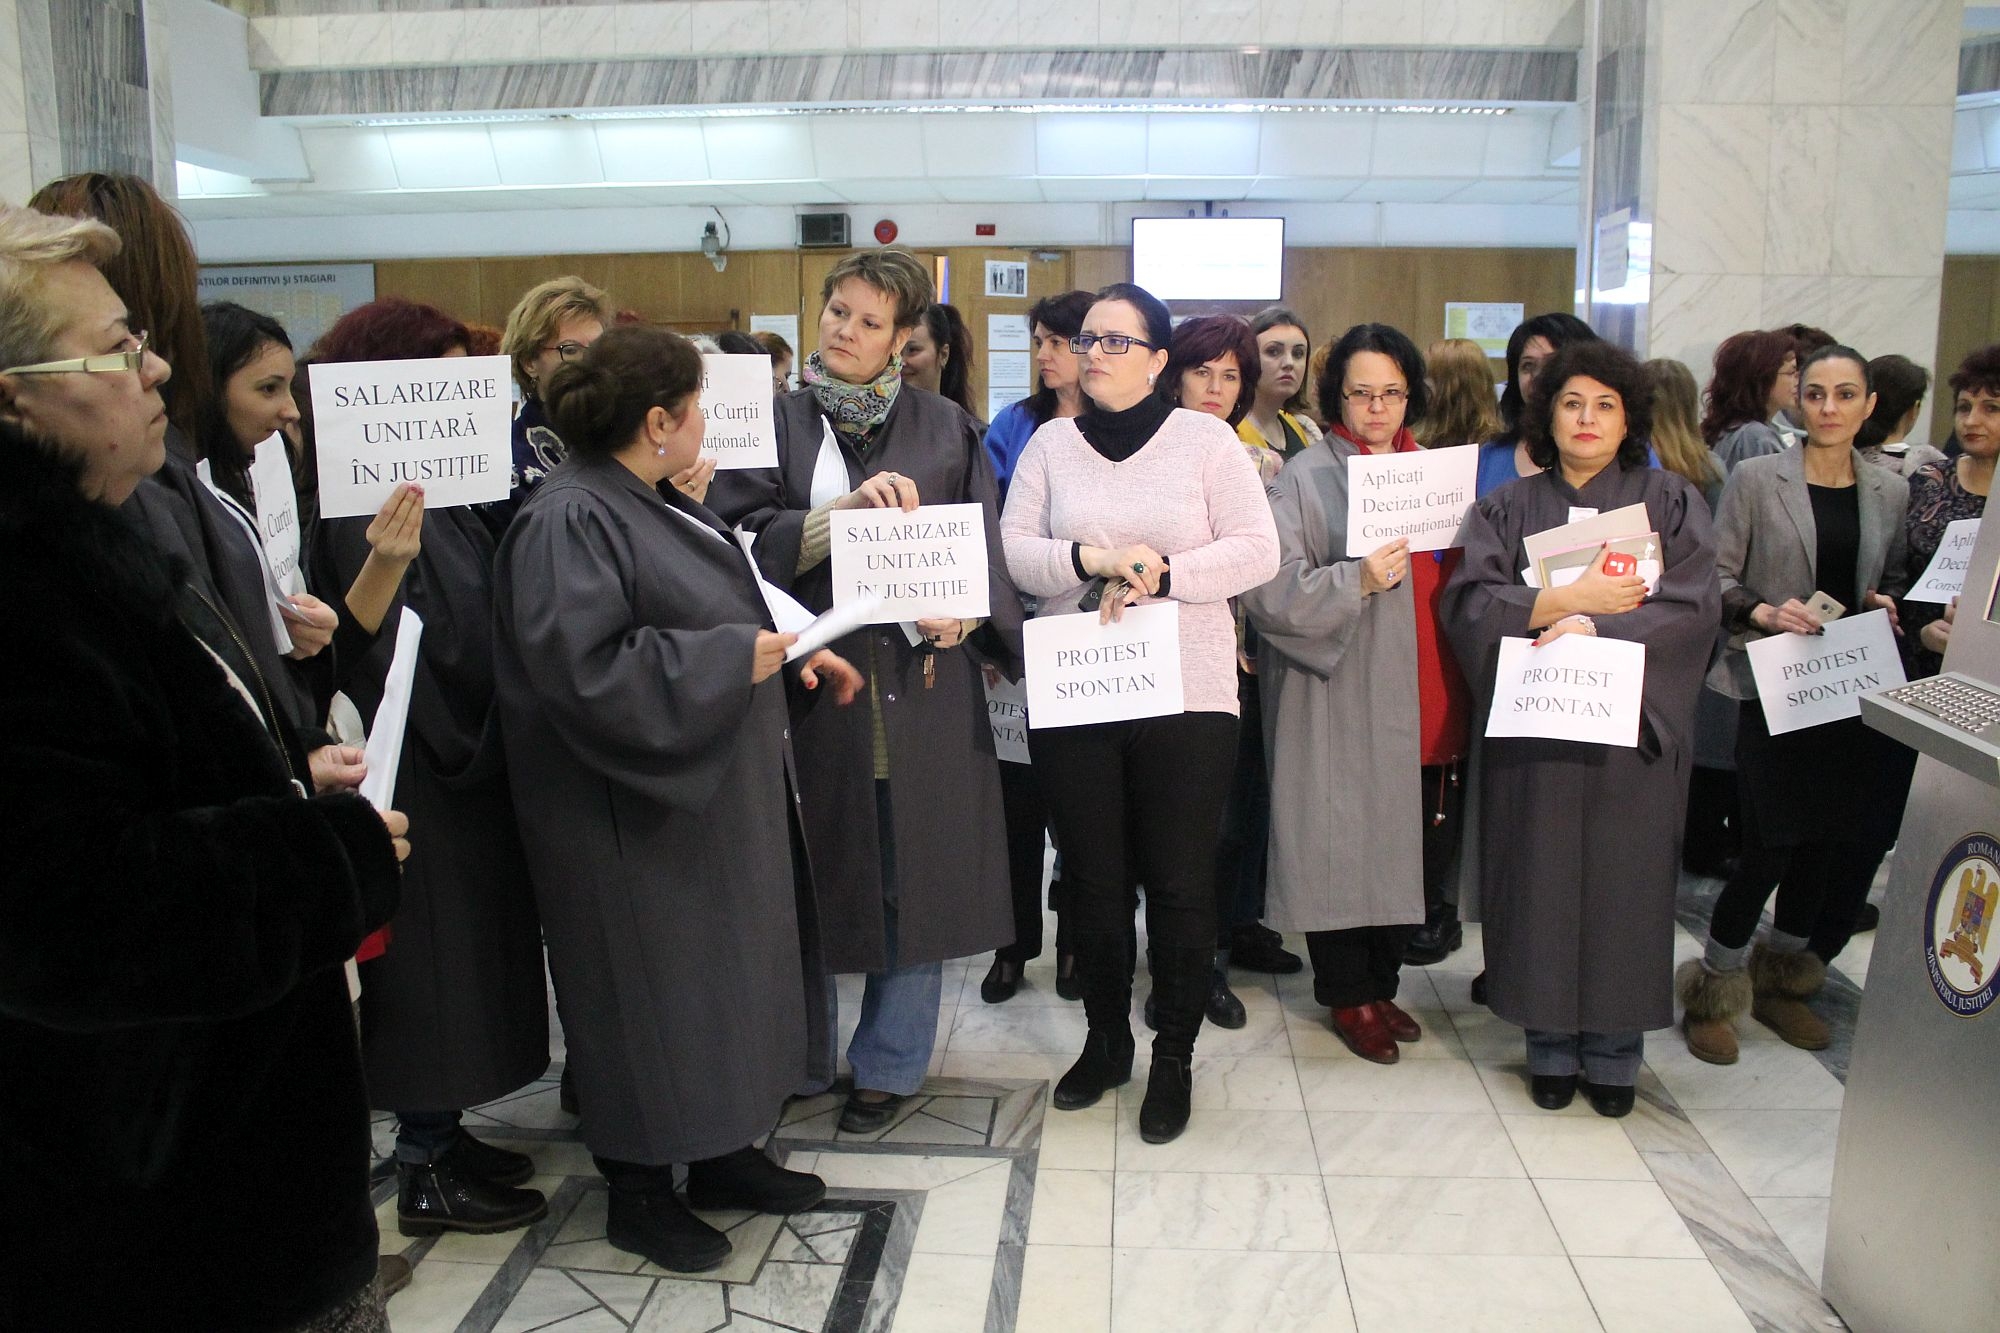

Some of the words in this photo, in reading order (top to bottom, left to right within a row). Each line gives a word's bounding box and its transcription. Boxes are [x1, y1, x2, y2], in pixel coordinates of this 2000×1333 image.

[232, 276, 280, 286] DEFINITIVI
[293, 274, 336, 285] STAGIARI
[334, 378, 497, 408] SALARIZARE
[714, 402, 759, 423] Curții
[363, 411, 478, 444] UNITARĂ
[351, 458, 381, 485] ÎN
[390, 453, 490, 483] JUSTIȚIE
[1361, 466, 1424, 490] Aplicați
[1362, 494, 1421, 513] Decizia
[1425, 487, 1464, 507] Curții
[847, 521, 972, 543] SALARIZARE
[1362, 514, 1463, 538] Constituționale
[866, 547, 957, 570] UNITARĂ
[884, 579, 969, 600] JUSTIȚIE
[1056, 641, 1150, 667] PROTEST
[1781, 646, 1869, 680] PROTEST
[1056, 673, 1156, 700] SPONTAN
[1522, 667, 1613, 688] PROTEST
[1786, 672, 1881, 707] SPONTAN
[1513, 696, 1613, 718] SPONTAN
[1926, 946, 1958, 1008] MINISTERUL
